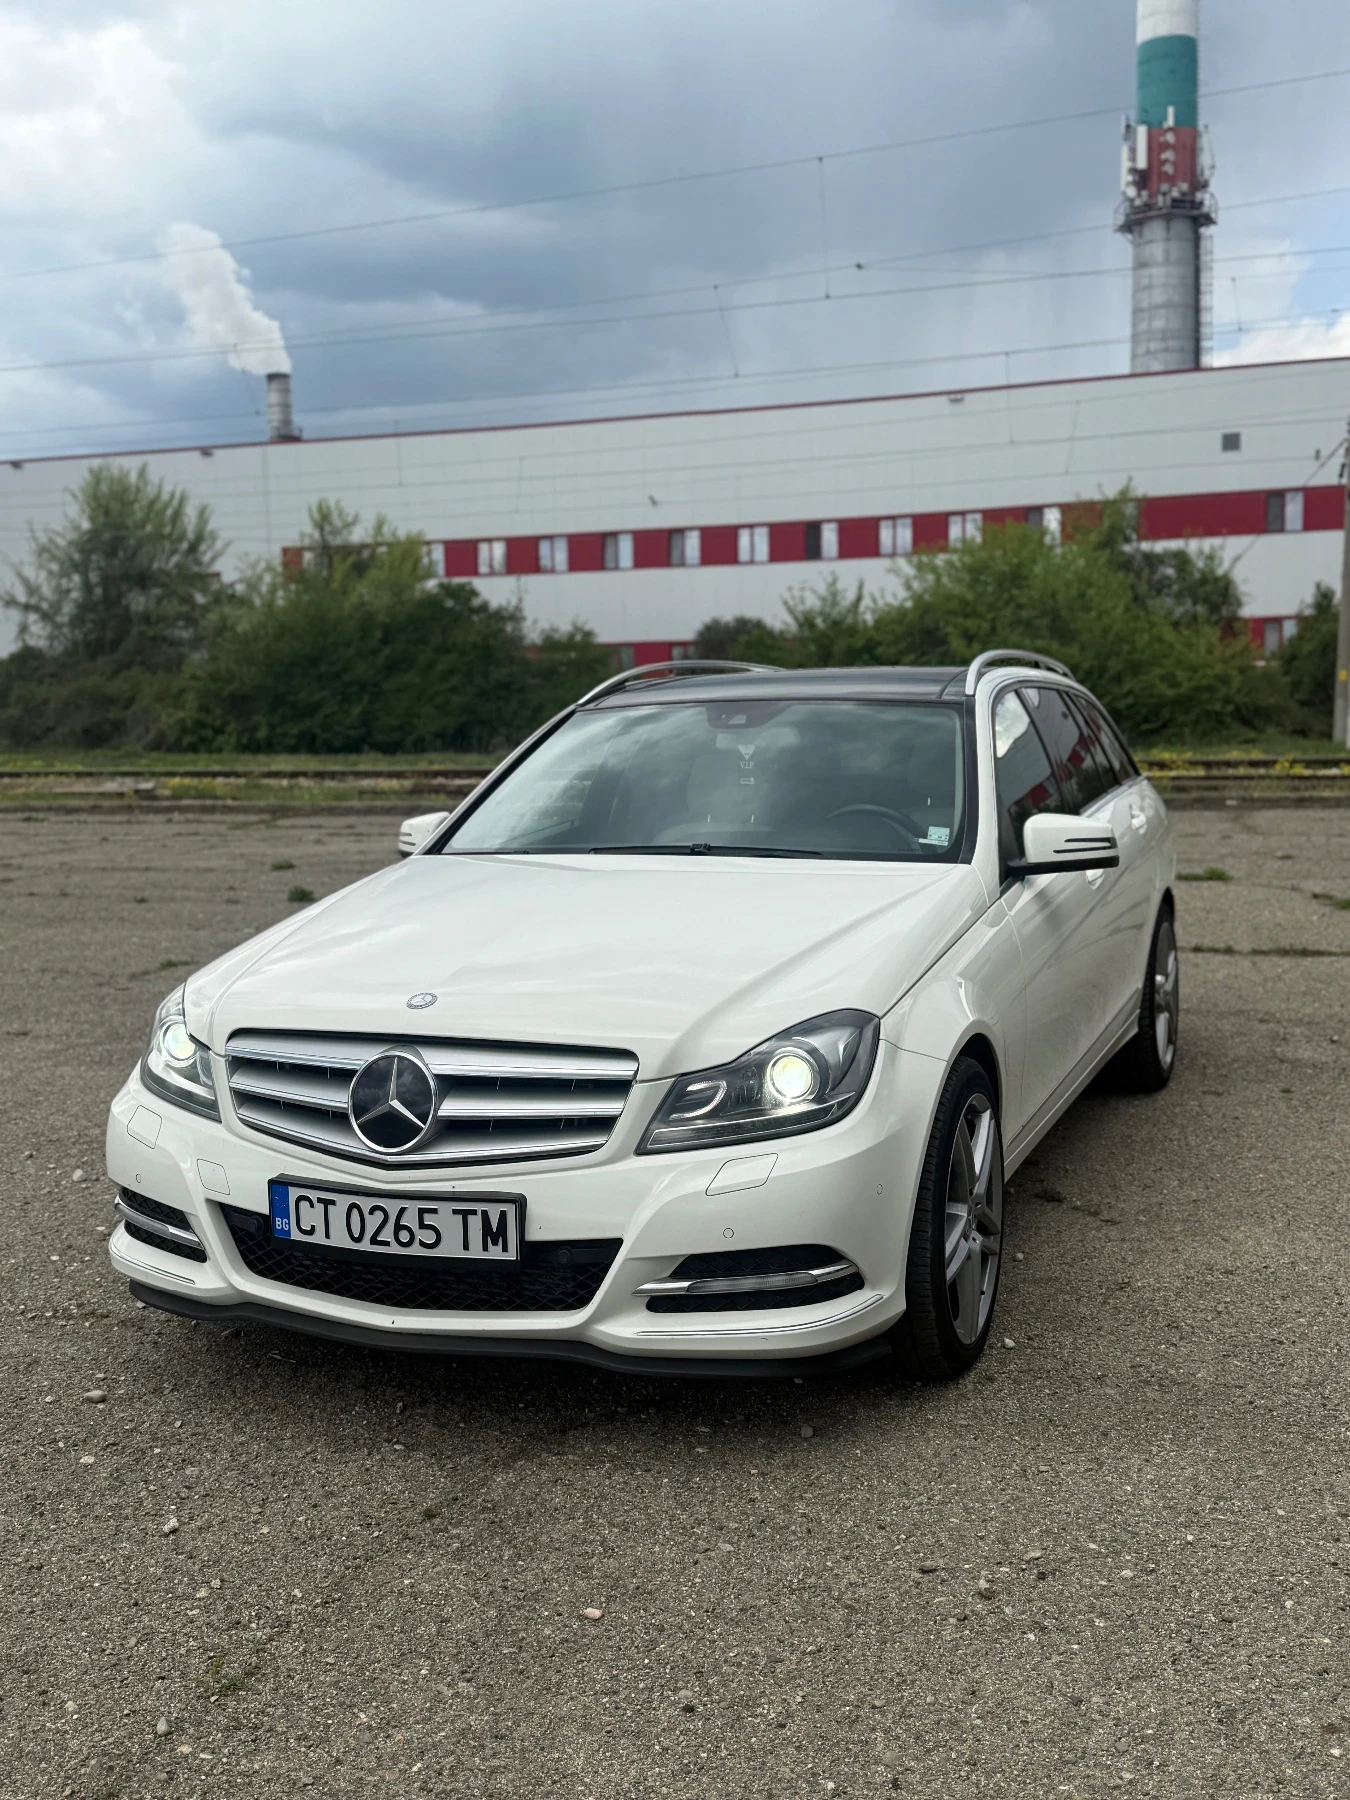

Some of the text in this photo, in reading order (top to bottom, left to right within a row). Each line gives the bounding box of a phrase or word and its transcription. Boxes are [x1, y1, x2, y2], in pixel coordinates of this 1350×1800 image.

[275, 1217, 289, 1231] BG
[294, 1193, 509, 1253] CT 0265 TM
